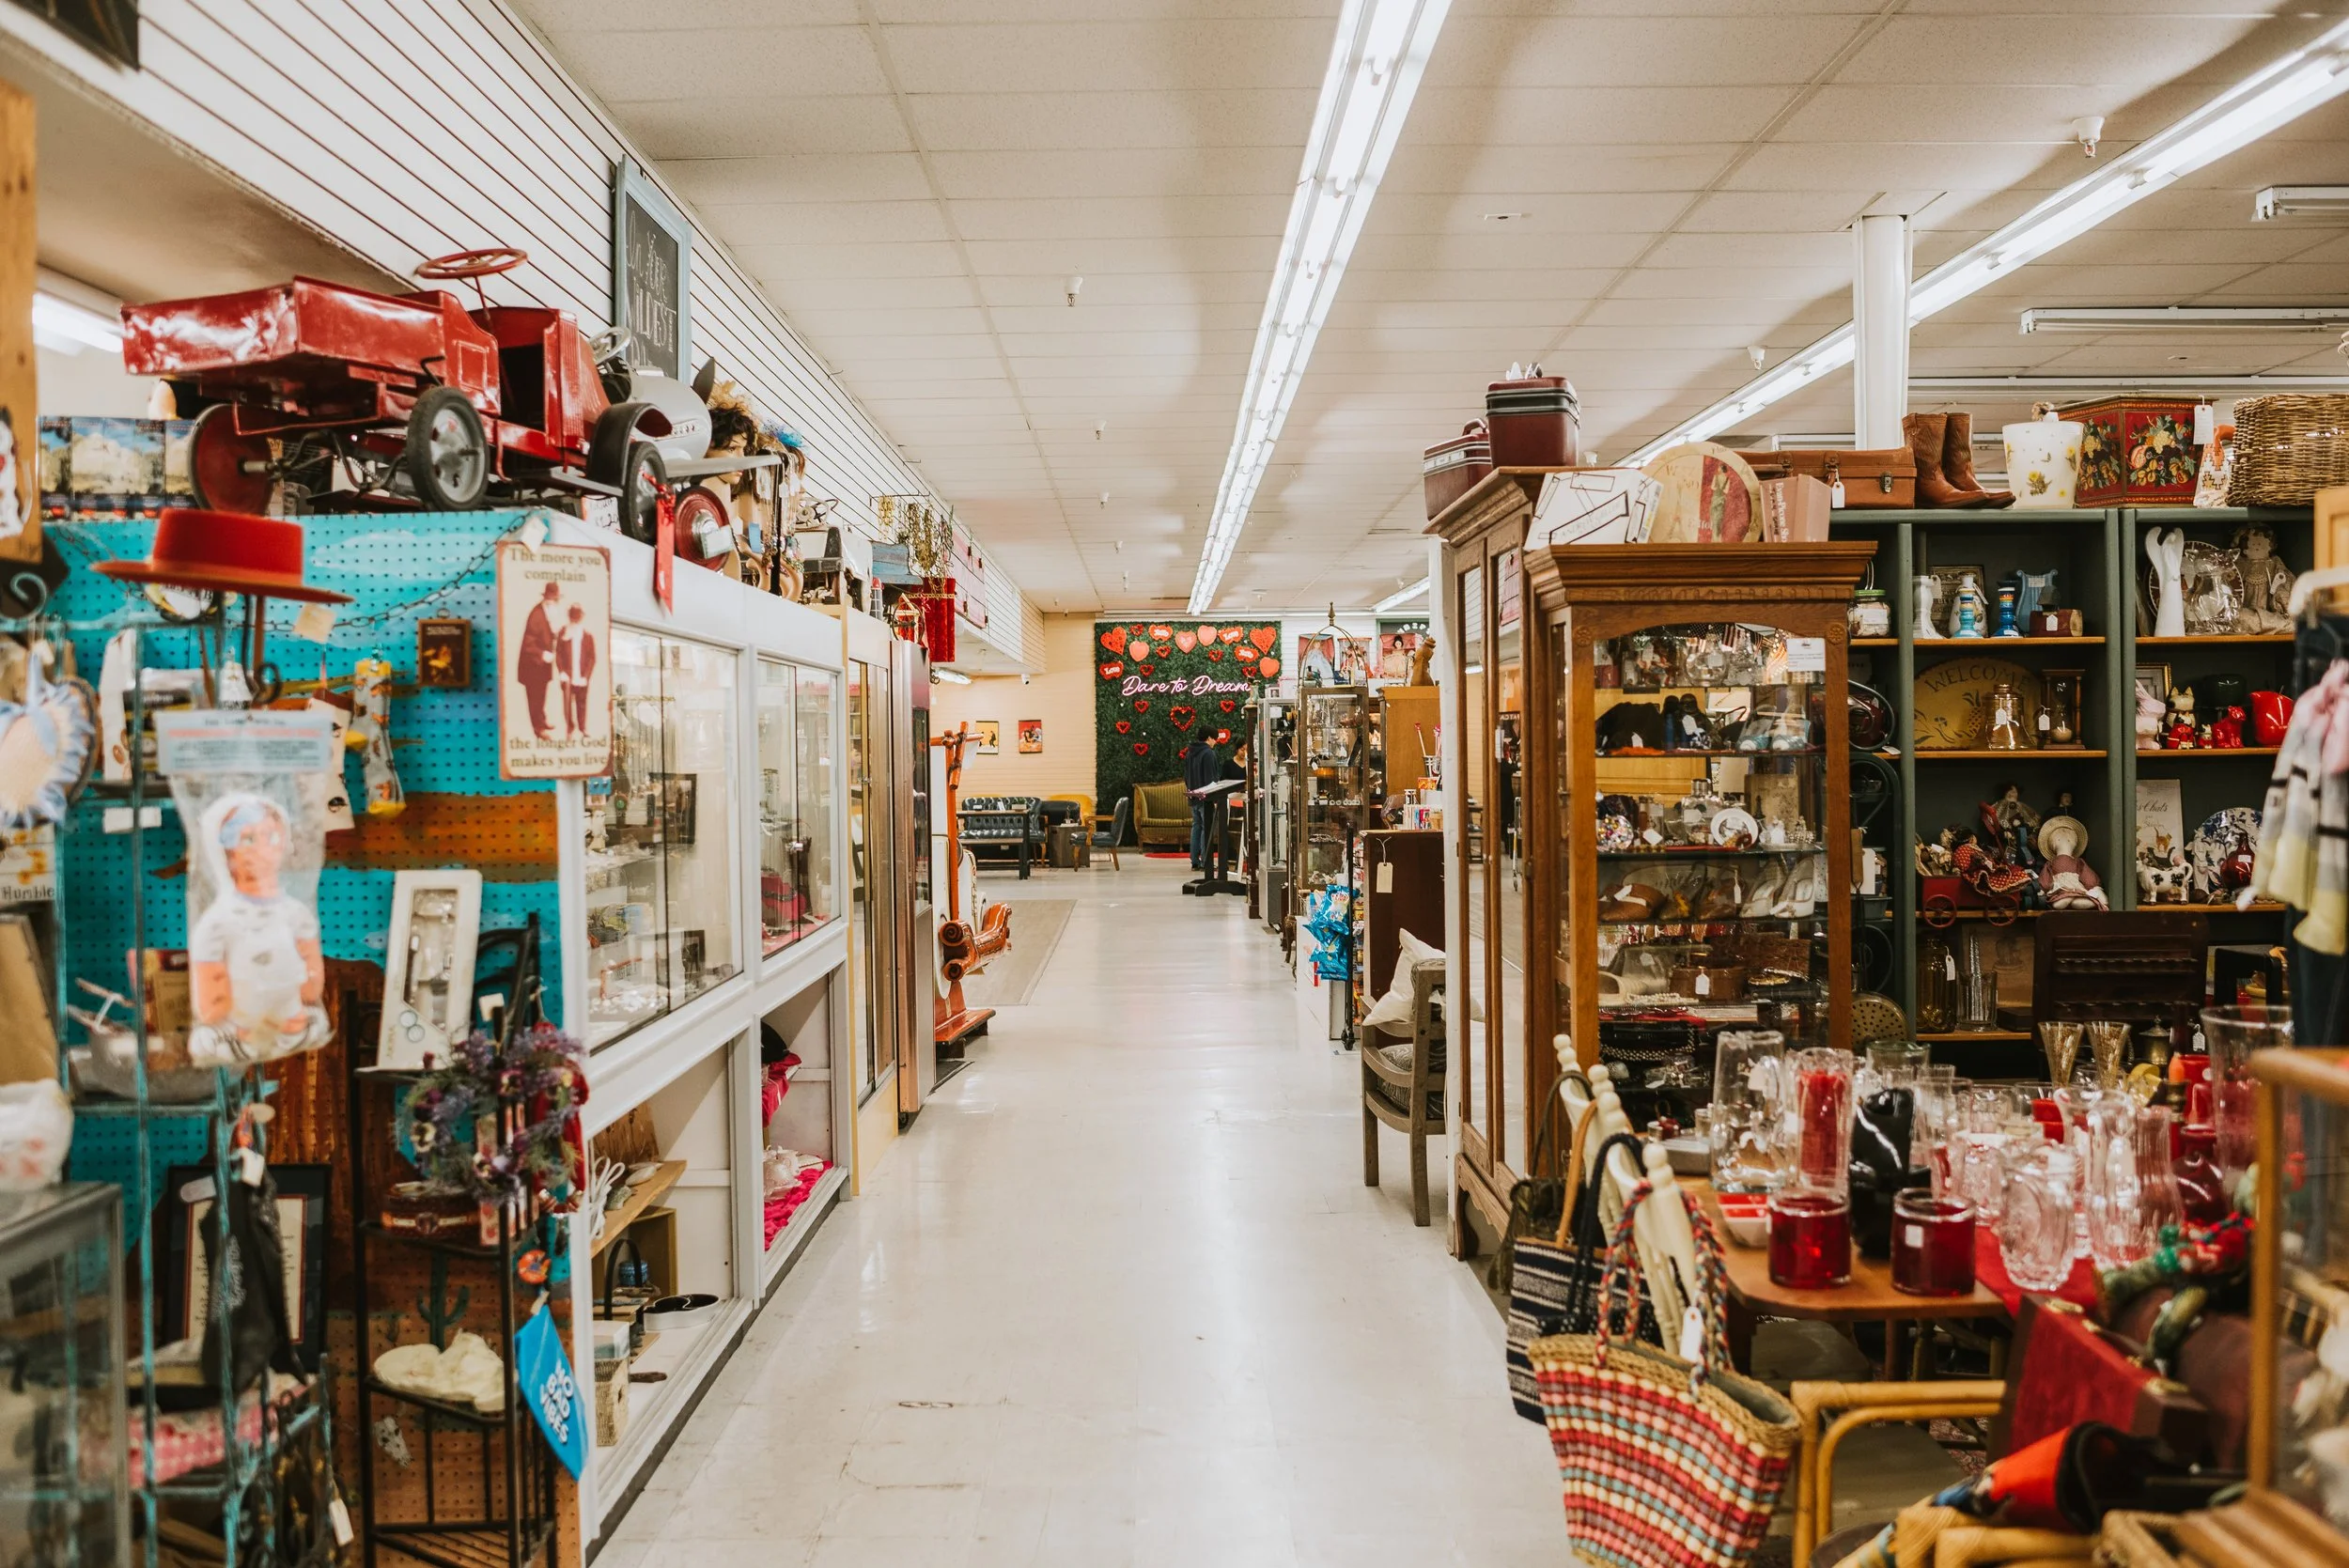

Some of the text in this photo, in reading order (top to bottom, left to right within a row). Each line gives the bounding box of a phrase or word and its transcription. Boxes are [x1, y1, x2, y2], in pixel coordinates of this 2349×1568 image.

[510, 548, 601, 567] The more you
[524, 568, 586, 582] complain
[1122, 675, 1252, 696] Dare to Dream
[1924, 664, 2031, 693] WELCOME
[510, 735, 608, 752] the longer God
[510, 752, 608, 768] makes you live
[2, 885, 54, 900] Humble
[555, 1358, 573, 1398] NO
[547, 1373, 570, 1419] BAD
[539, 1383, 568, 1443] VIBES
